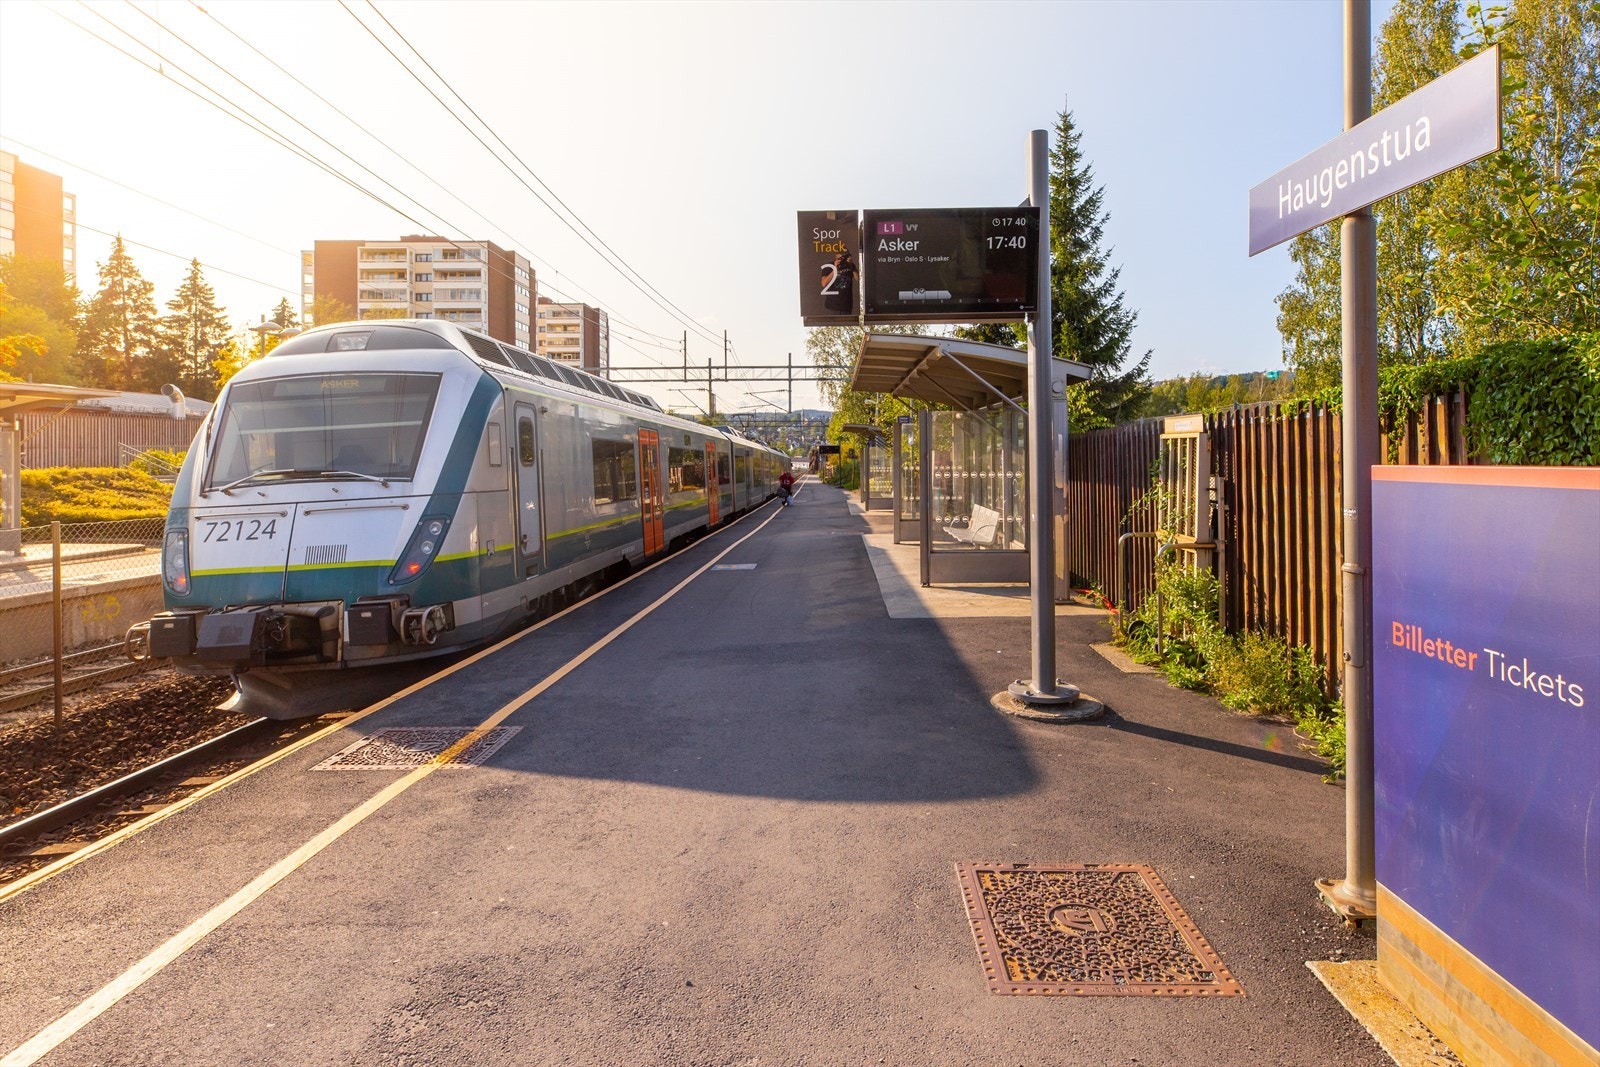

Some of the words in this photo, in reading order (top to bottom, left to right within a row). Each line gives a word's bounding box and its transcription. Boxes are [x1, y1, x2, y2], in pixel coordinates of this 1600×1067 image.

[1278, 115, 1431, 219] Haugenstua
[883, 223, 895, 233] L1
[1002, 217, 1013, 226] 17
[1015, 217, 1026, 226] 40
[812, 227, 841, 242] Spor
[812, 240, 847, 253] Track
[877, 237, 920, 252] Asker
[986, 235, 1027, 250] 17:40
[887, 256, 901, 264] Bryn
[927, 255, 950, 263] Lysaker
[820, 263, 840, 296] 2
[320, 379, 360, 391] ASKER
[203, 519, 277, 543] 72124
[1392, 620, 1479, 672] Billetter
[1483, 647, 1585, 708] Tickets
